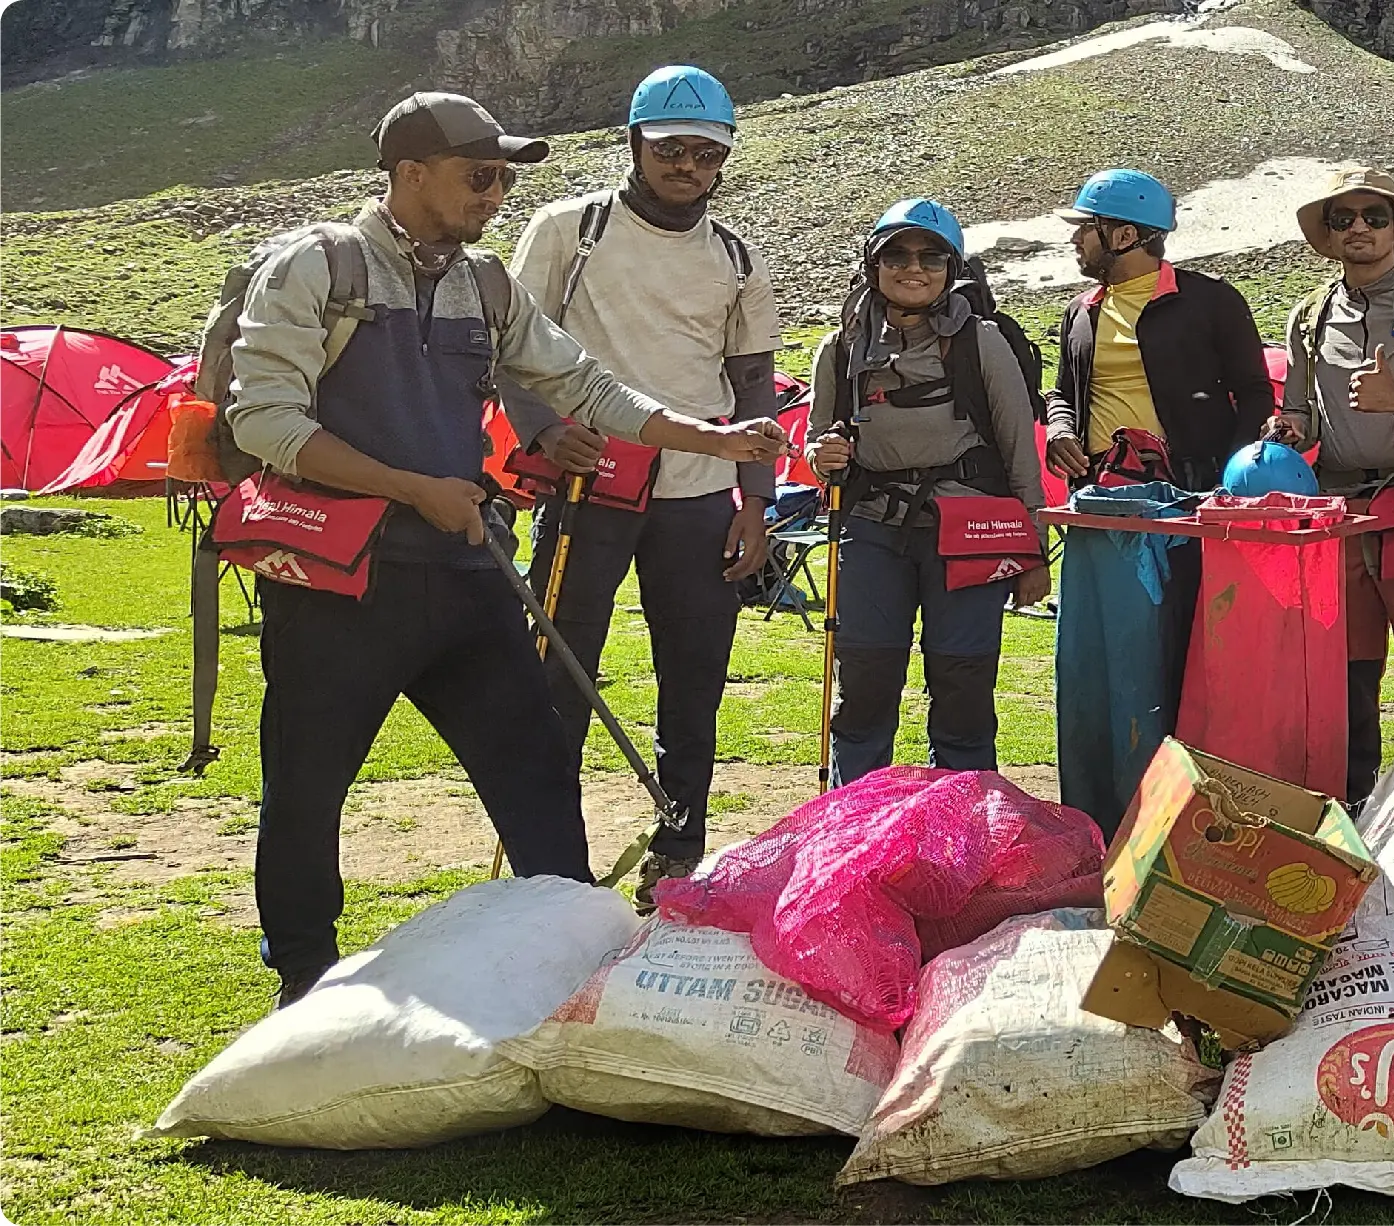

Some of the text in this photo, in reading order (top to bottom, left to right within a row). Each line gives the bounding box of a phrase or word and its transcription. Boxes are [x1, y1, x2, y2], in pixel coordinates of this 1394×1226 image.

[282, 502, 328, 523] Himala
[635, 969, 737, 1002] UTTAM
[1303, 978, 1390, 1011] MACARO
[1312, 1005, 1385, 1027] INDIAN TASTE
